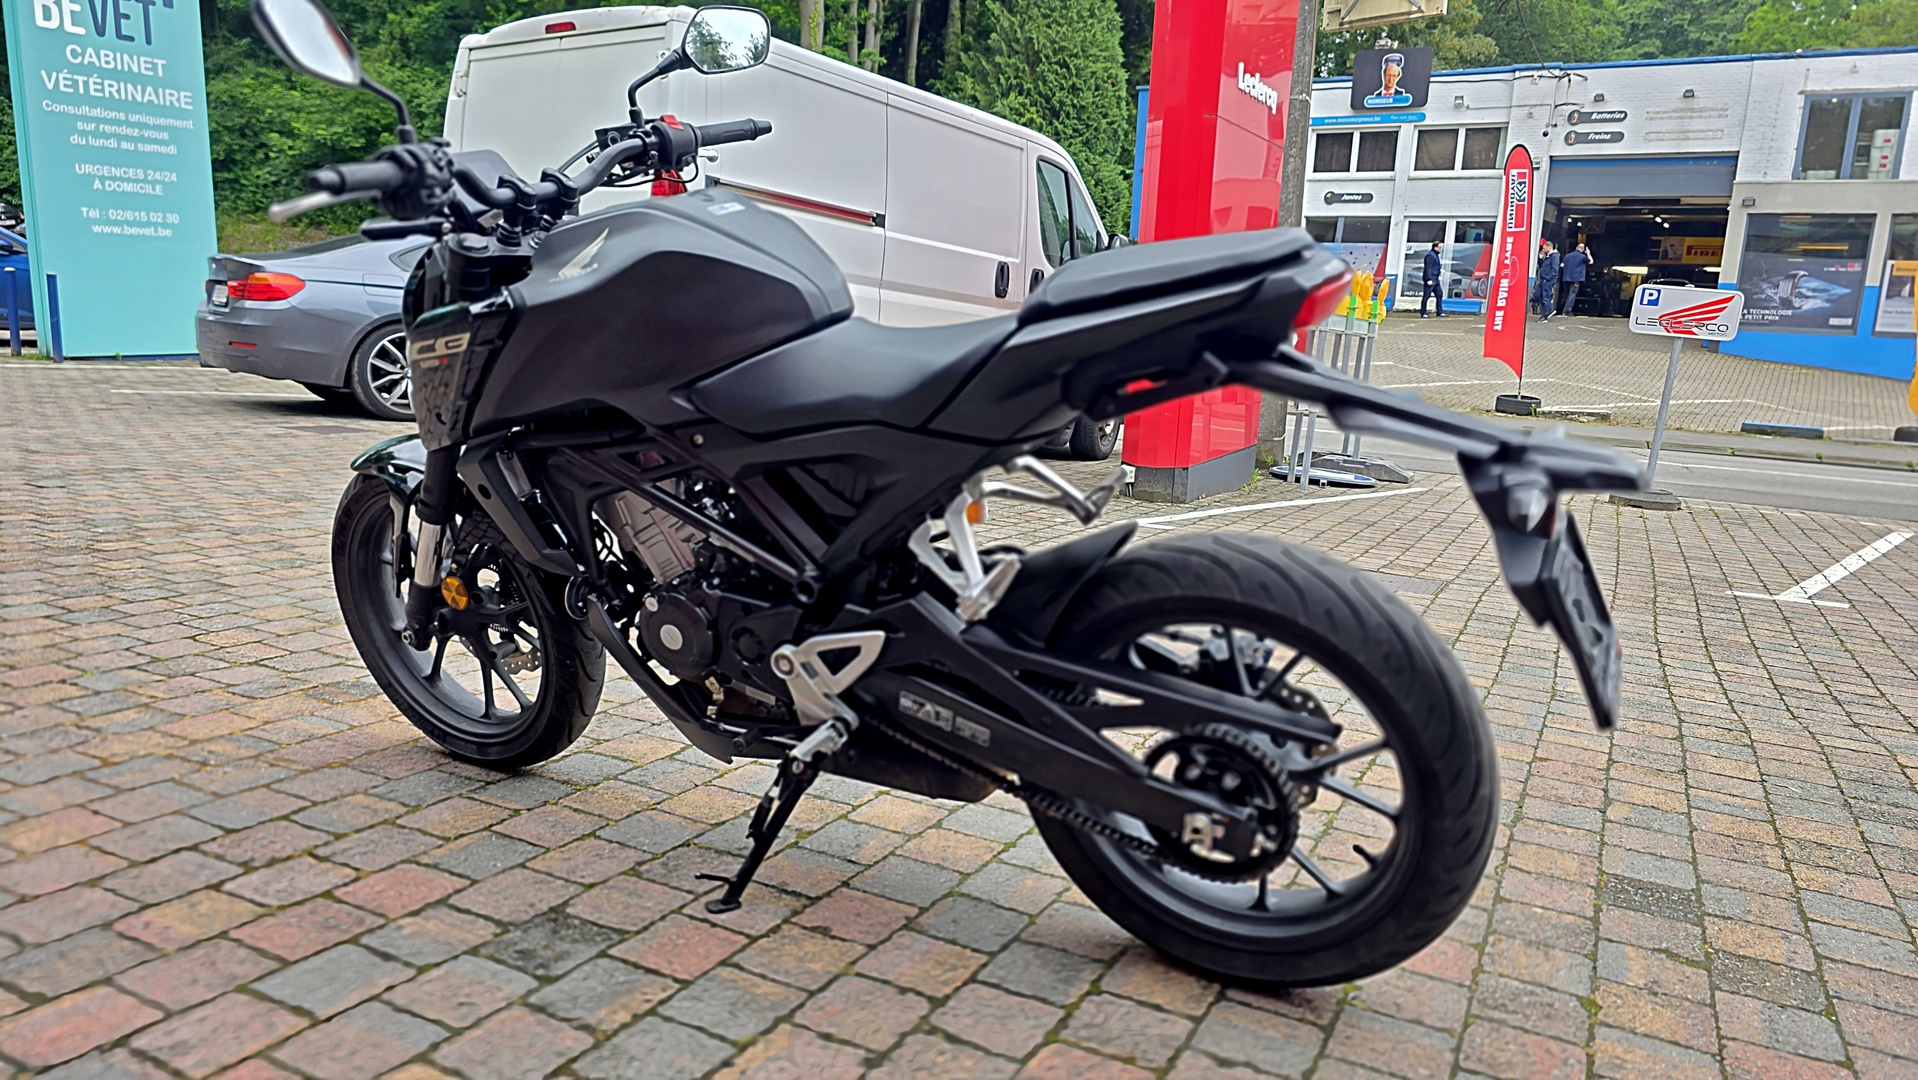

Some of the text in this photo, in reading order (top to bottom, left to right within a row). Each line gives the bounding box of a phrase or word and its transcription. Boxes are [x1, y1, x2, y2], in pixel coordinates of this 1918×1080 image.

[65, 44, 167, 78] CABINET
[40, 69, 194, 110] VÉTÉRINAIRE
[1238, 61, 1278, 115] Leclercq
[42, 99, 194, 130] Consultations uniquement
[76, 120, 169, 140] sur rendez-vous
[69, 133, 178, 155] du lundi au samedi
[75, 162, 178, 182] URGENCES 24/24
[93, 177, 164, 196] À DOMICILE
[80, 206, 100, 219] Tél
[108, 208, 148, 222] 02/615
[149, 211, 163, 223] 02
[165, 212, 180, 224] 30
[91, 224, 173, 238] www.bevet.be
[1685, 244, 1723, 257] PIRE
[1642, 289, 1659, 305] P
[410, 332, 471, 361] CB
